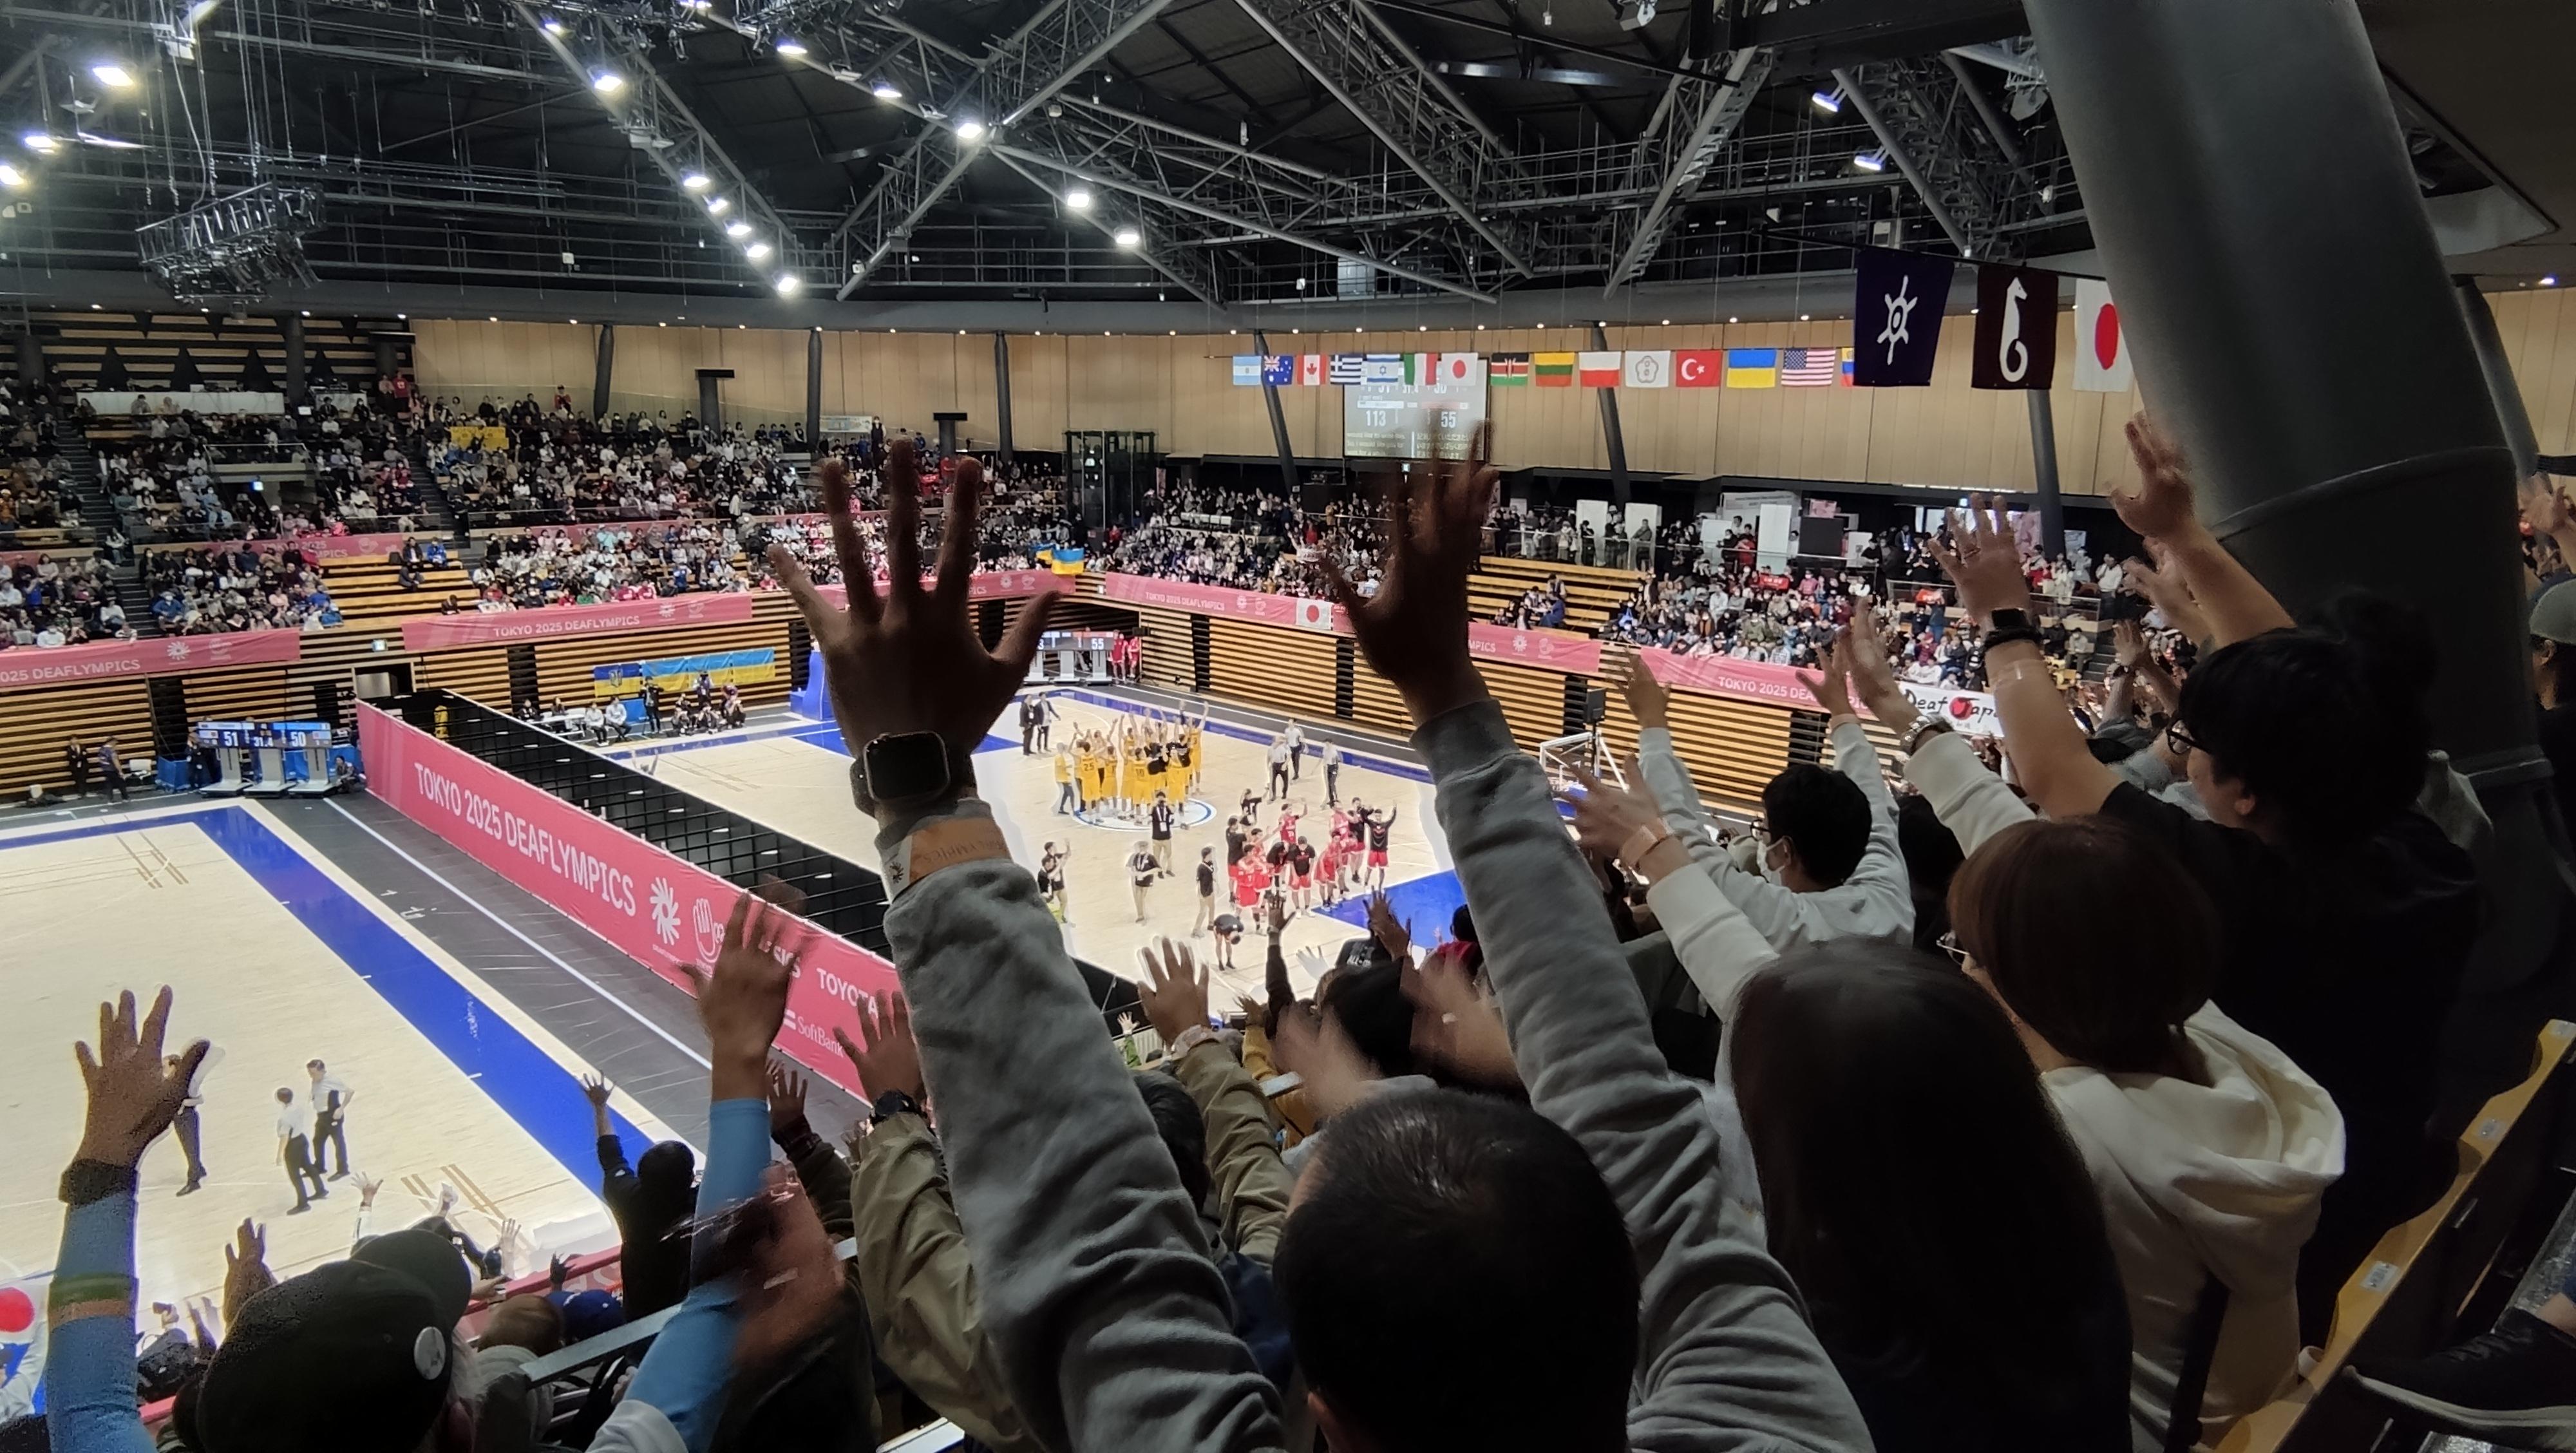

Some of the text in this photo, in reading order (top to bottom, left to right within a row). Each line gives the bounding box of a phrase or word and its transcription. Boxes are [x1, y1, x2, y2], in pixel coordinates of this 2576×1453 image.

[1366, 410, 1456, 428] 113 55
[1146, 591, 1166, 602] TOKYO
[1181, 598, 1225, 611] DEAFLYMPICS
[493, 616, 640, 637] TOKYO 2025 DEAFLYMPICS
[1091, 638, 1104, 650] 55
[0, 660, 141, 682] 025 DEAFLYMPICS
[1718, 676, 1756, 692] TOKYO
[1759, 683, 1787, 698] 2025
[223, 731, 307, 747] 51 31.4 50
[414, 762, 636, 917] TOKYO 2025 DEAFLYMPICS
[797, 1016, 844, 1058] SoftBank
